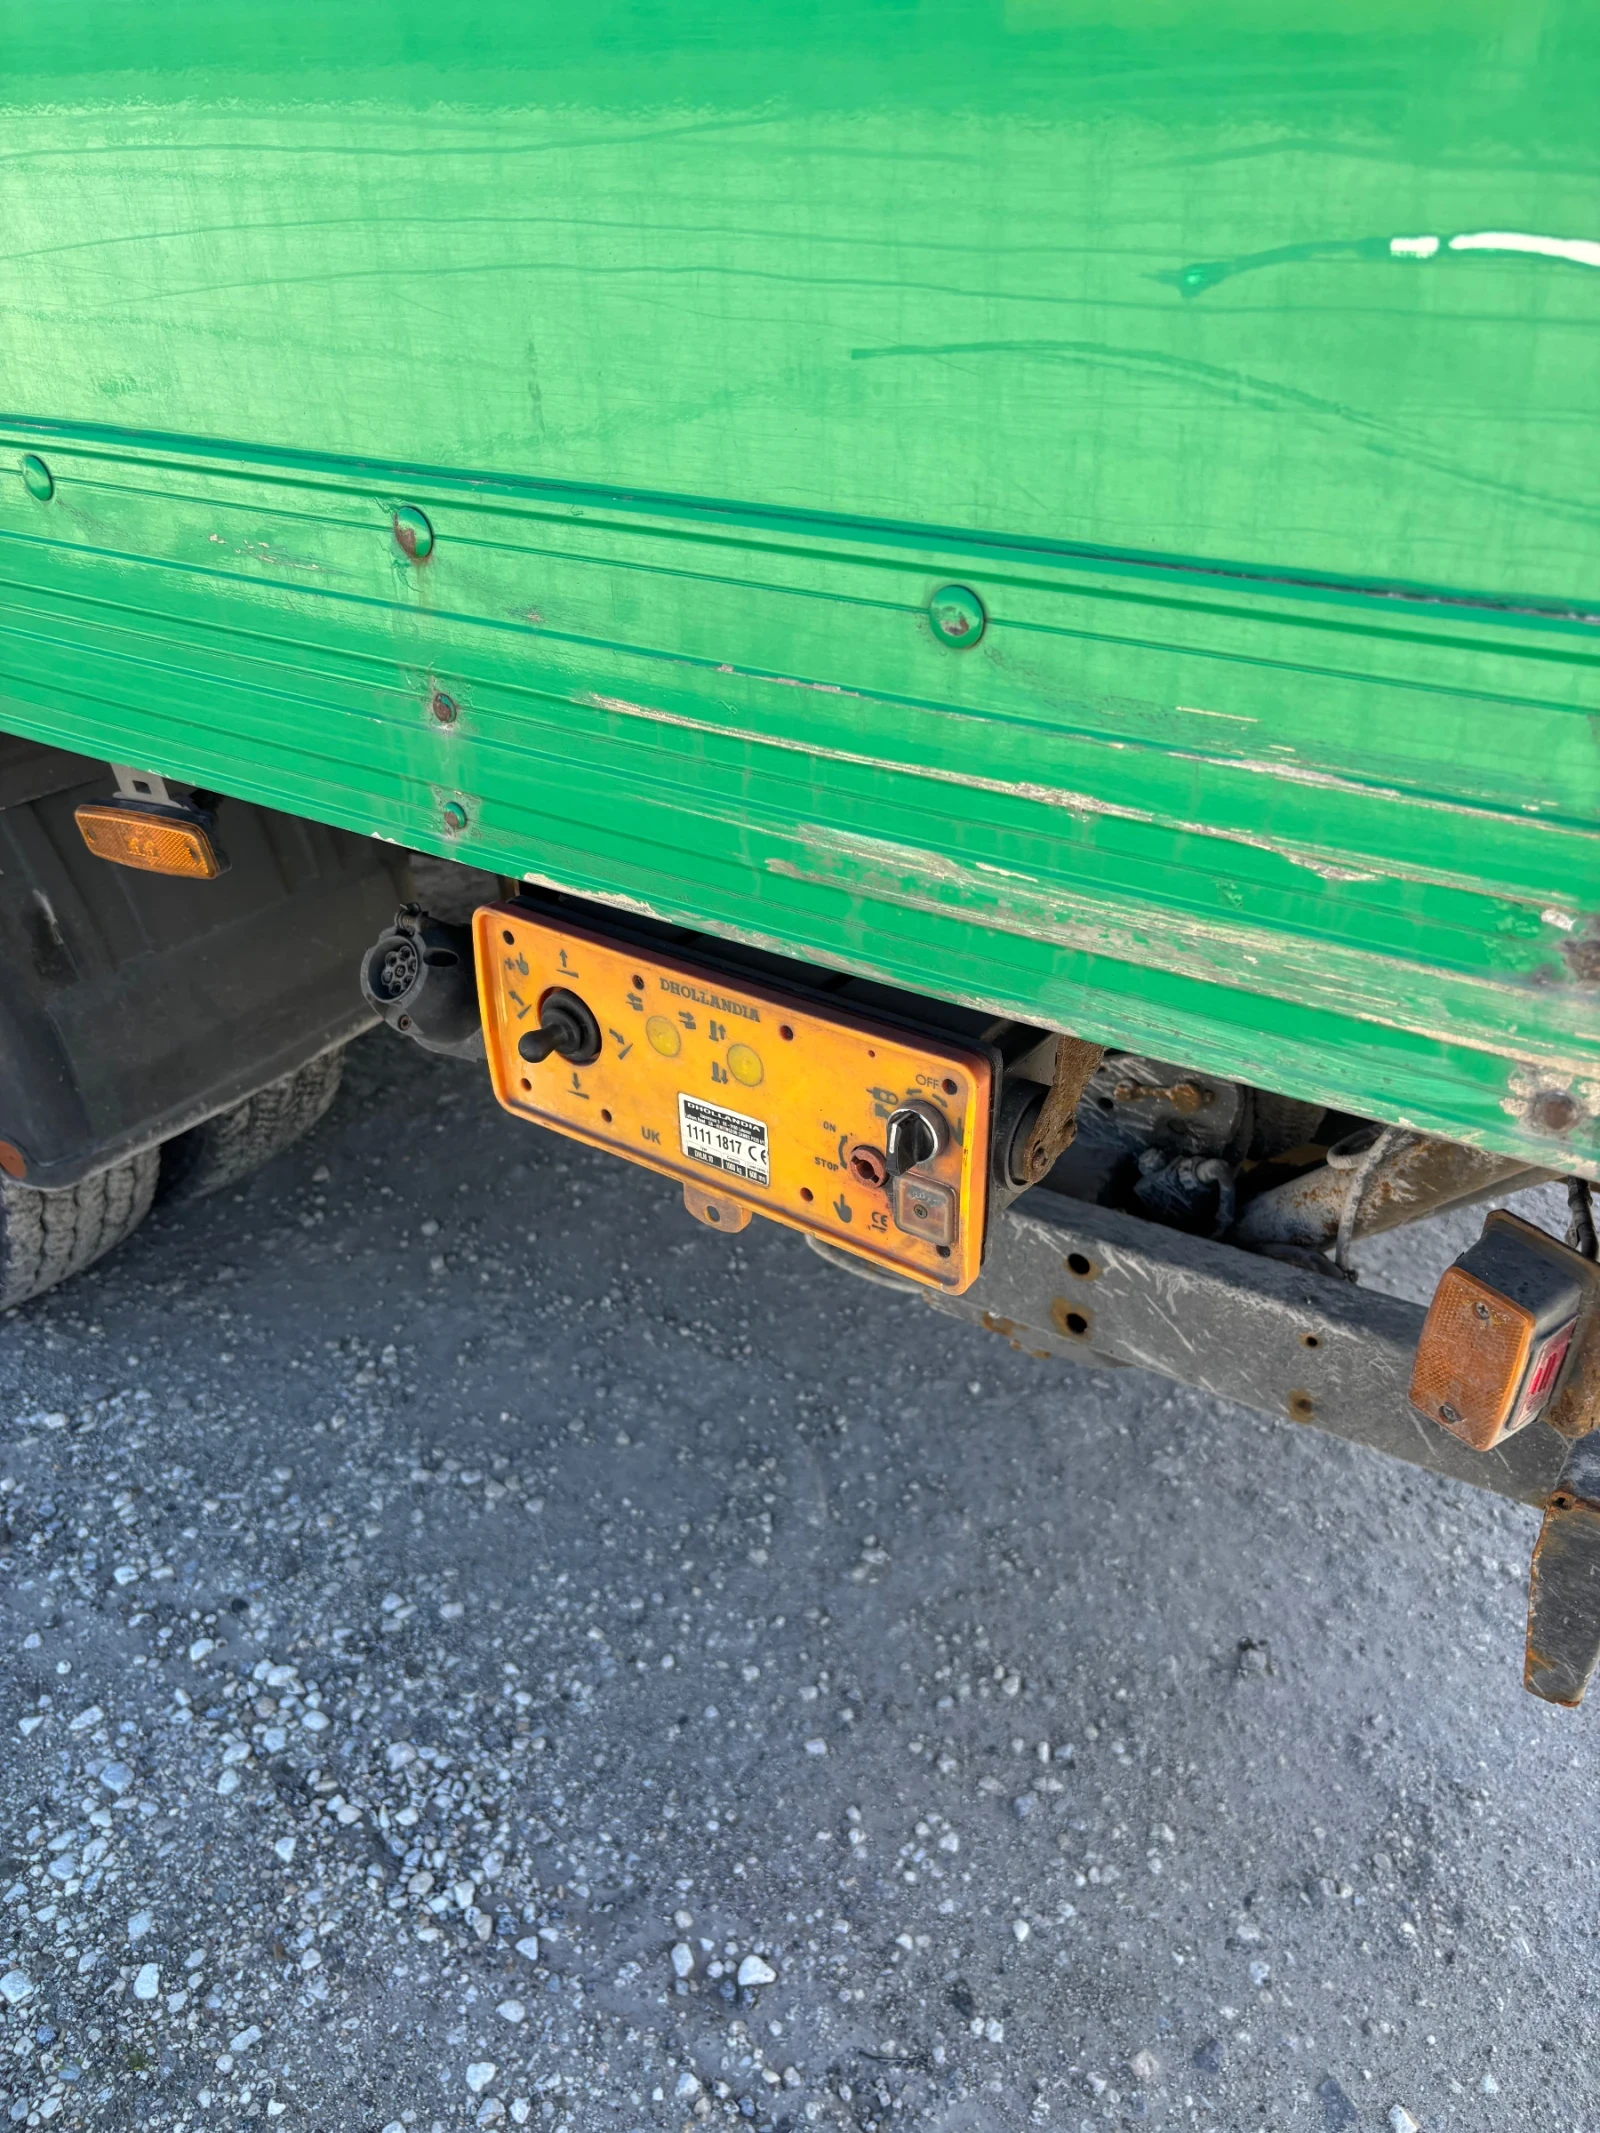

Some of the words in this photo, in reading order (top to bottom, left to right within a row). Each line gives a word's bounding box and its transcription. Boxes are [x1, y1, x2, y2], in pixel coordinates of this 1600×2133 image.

[659, 978, 761, 1023] DHOLLANDIA
[915, 1074, 940, 1089] OFF
[687, 1102, 761, 1133] DHOLLANDIA
[823, 1121, 837, 1133] ON
[641, 1125, 661, 1146] UK
[686, 1123, 711, 1146] 1111
[716, 1134, 742, 1155] 1817
[814, 1156, 839, 1172] STOP
